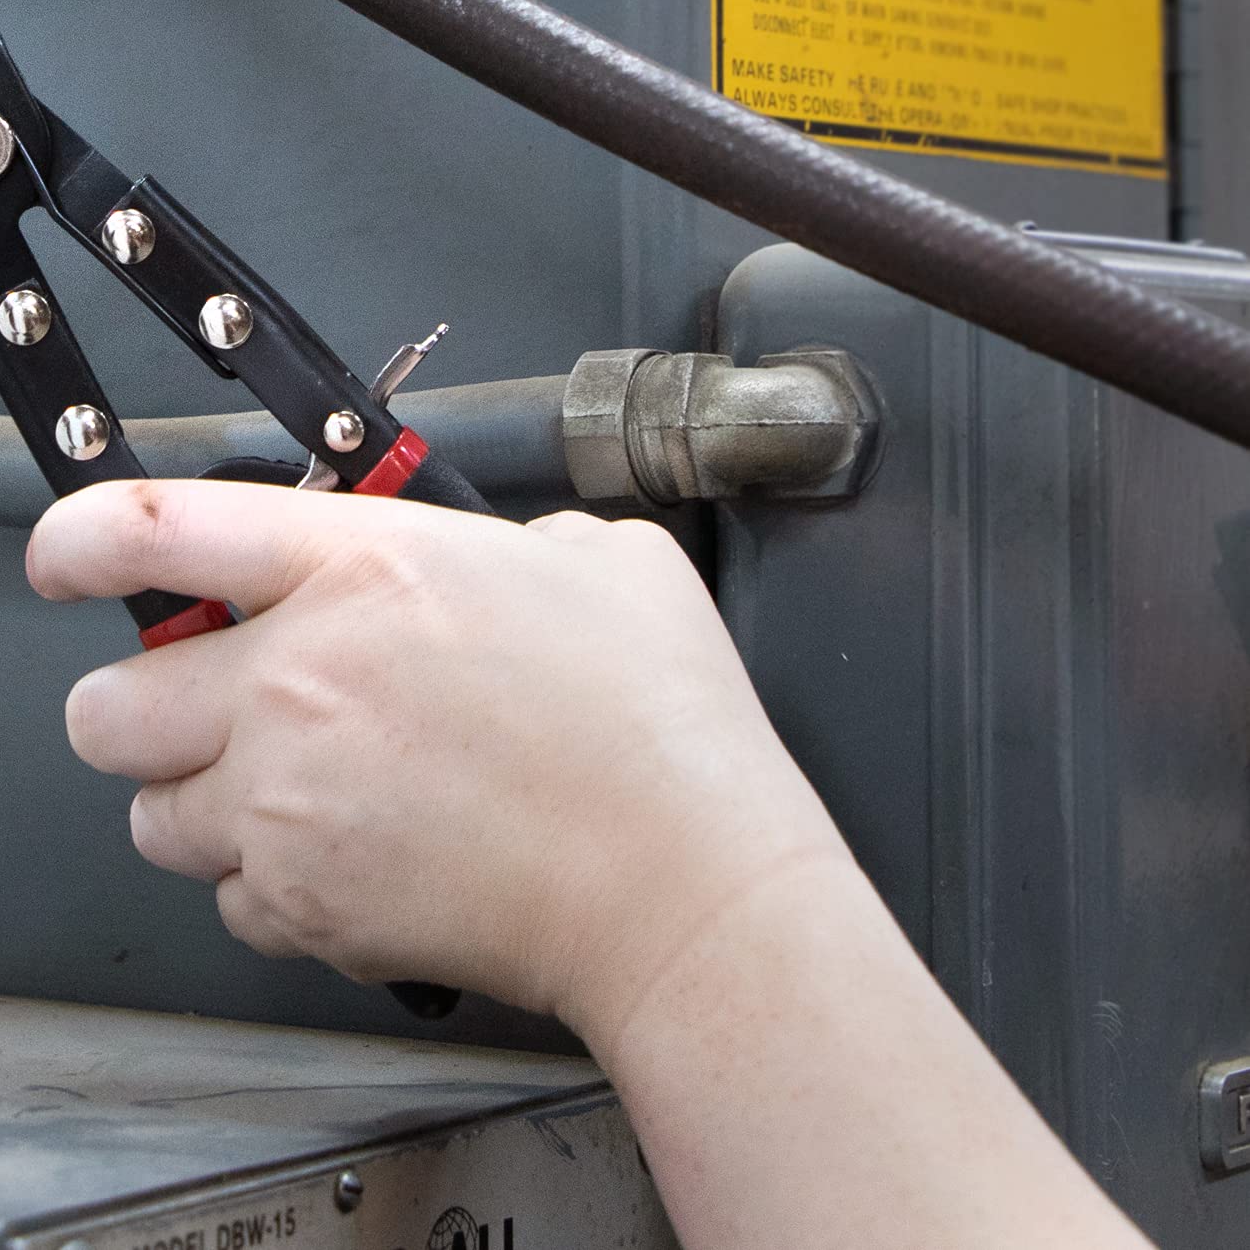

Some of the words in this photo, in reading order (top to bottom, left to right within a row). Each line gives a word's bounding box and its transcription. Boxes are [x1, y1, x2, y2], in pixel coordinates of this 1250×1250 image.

[752, 11, 807, 36] DISCONNECT
[731, 58, 774, 80] MAKE
[779, 64, 835, 88] SAFETY
[869, 75, 903, 96] RUE
[732, 86, 797, 111] ALWAYS
[801, 95, 868, 120] CONSUT
[217, 1206, 297, 1250] DBW-15
